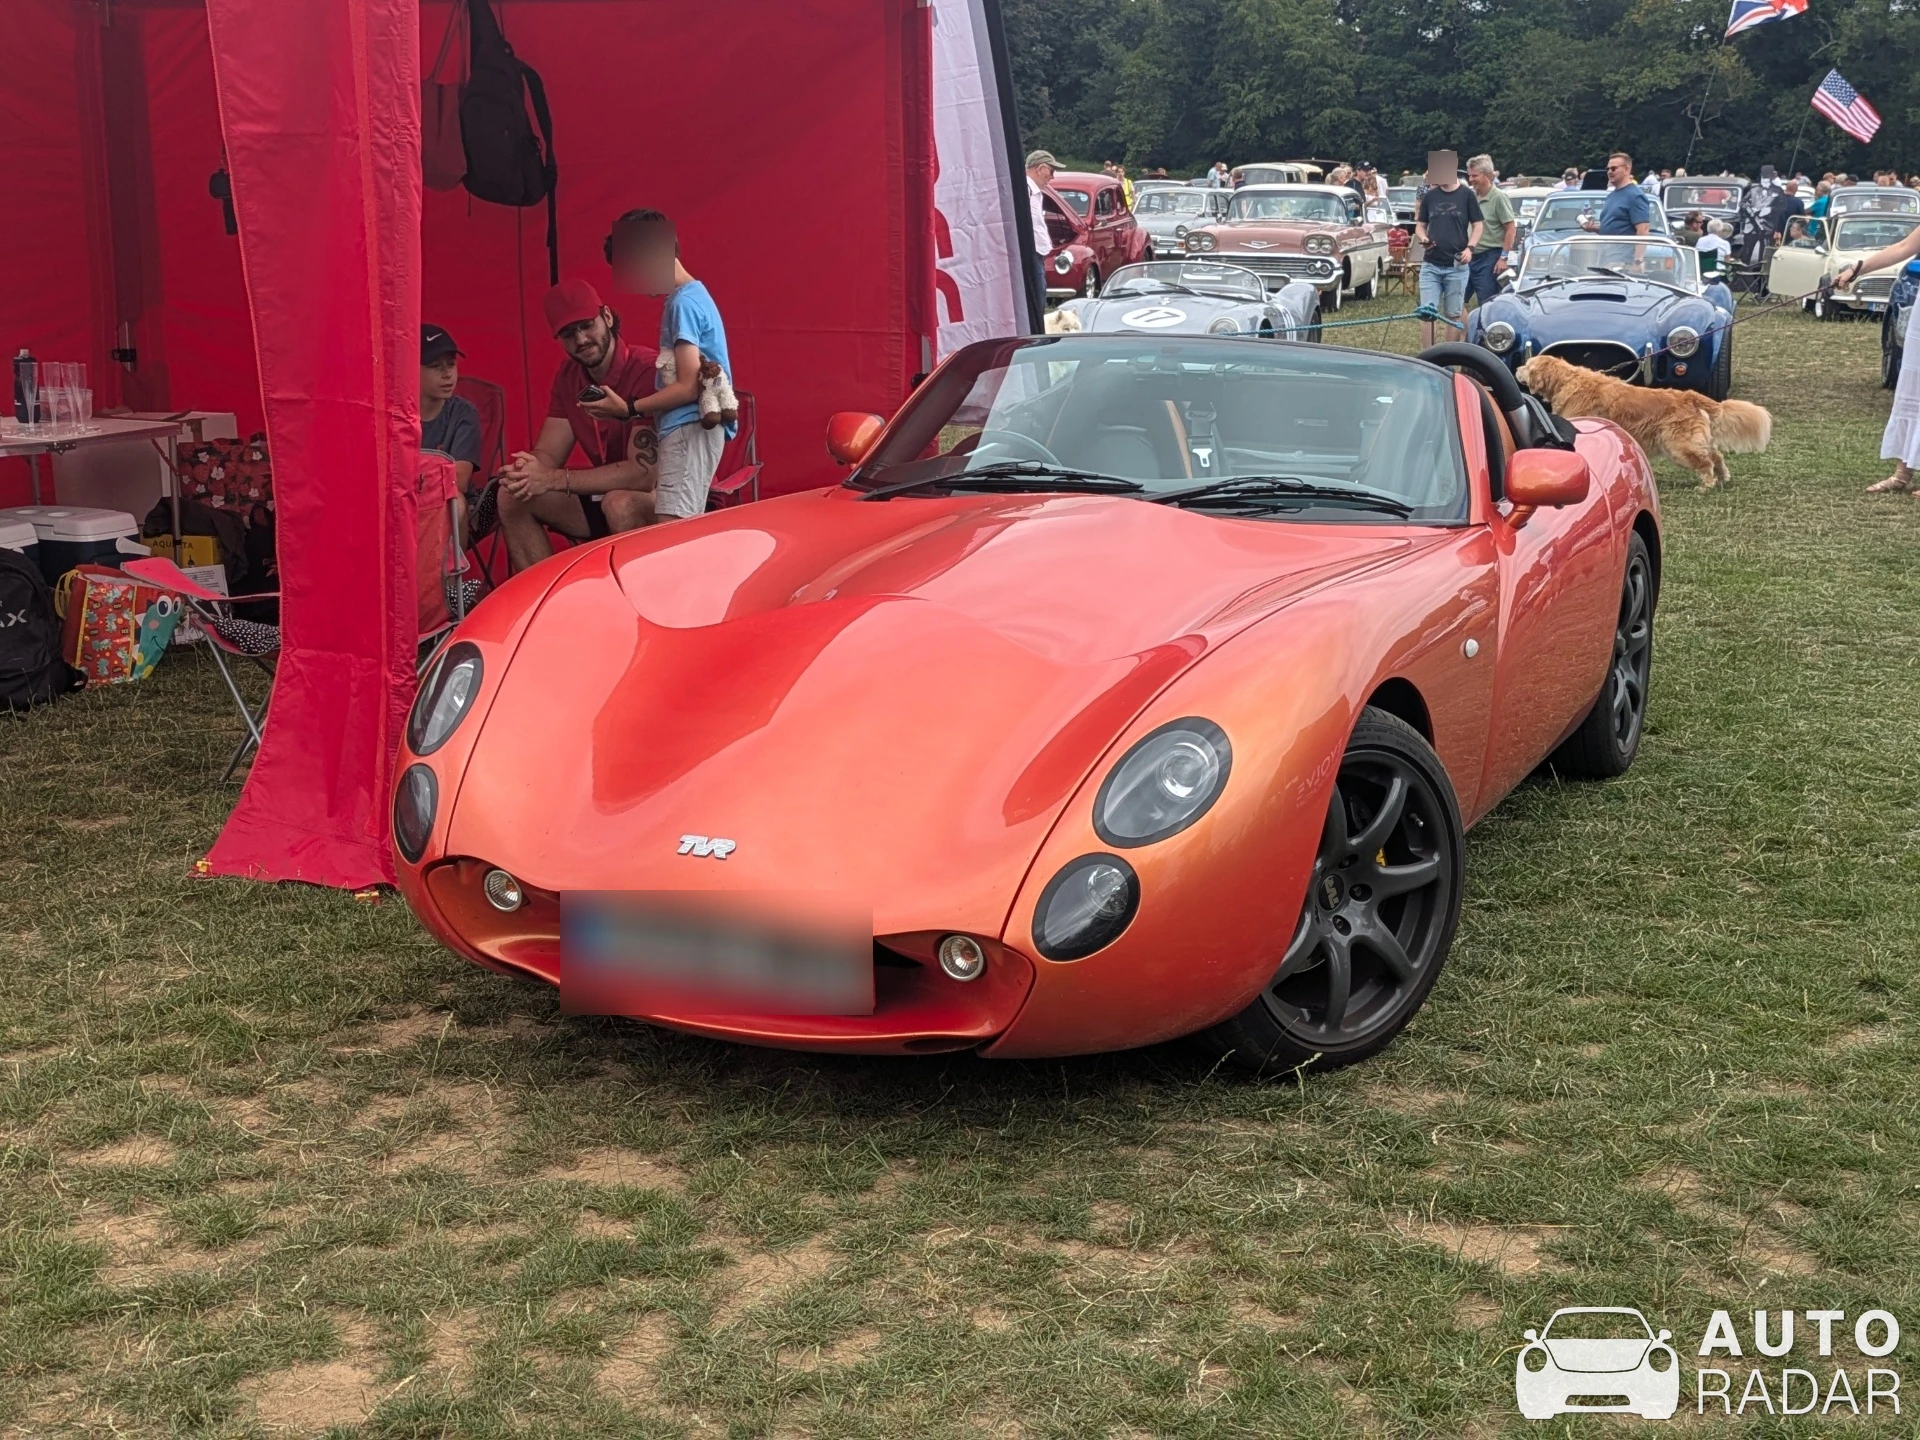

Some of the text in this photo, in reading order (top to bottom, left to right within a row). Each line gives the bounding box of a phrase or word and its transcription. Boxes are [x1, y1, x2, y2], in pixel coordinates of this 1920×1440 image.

[1132, 309, 1181, 323] 17
[676, 834, 737, 859] TVR
[1324, 876, 1340, 909] TVR
